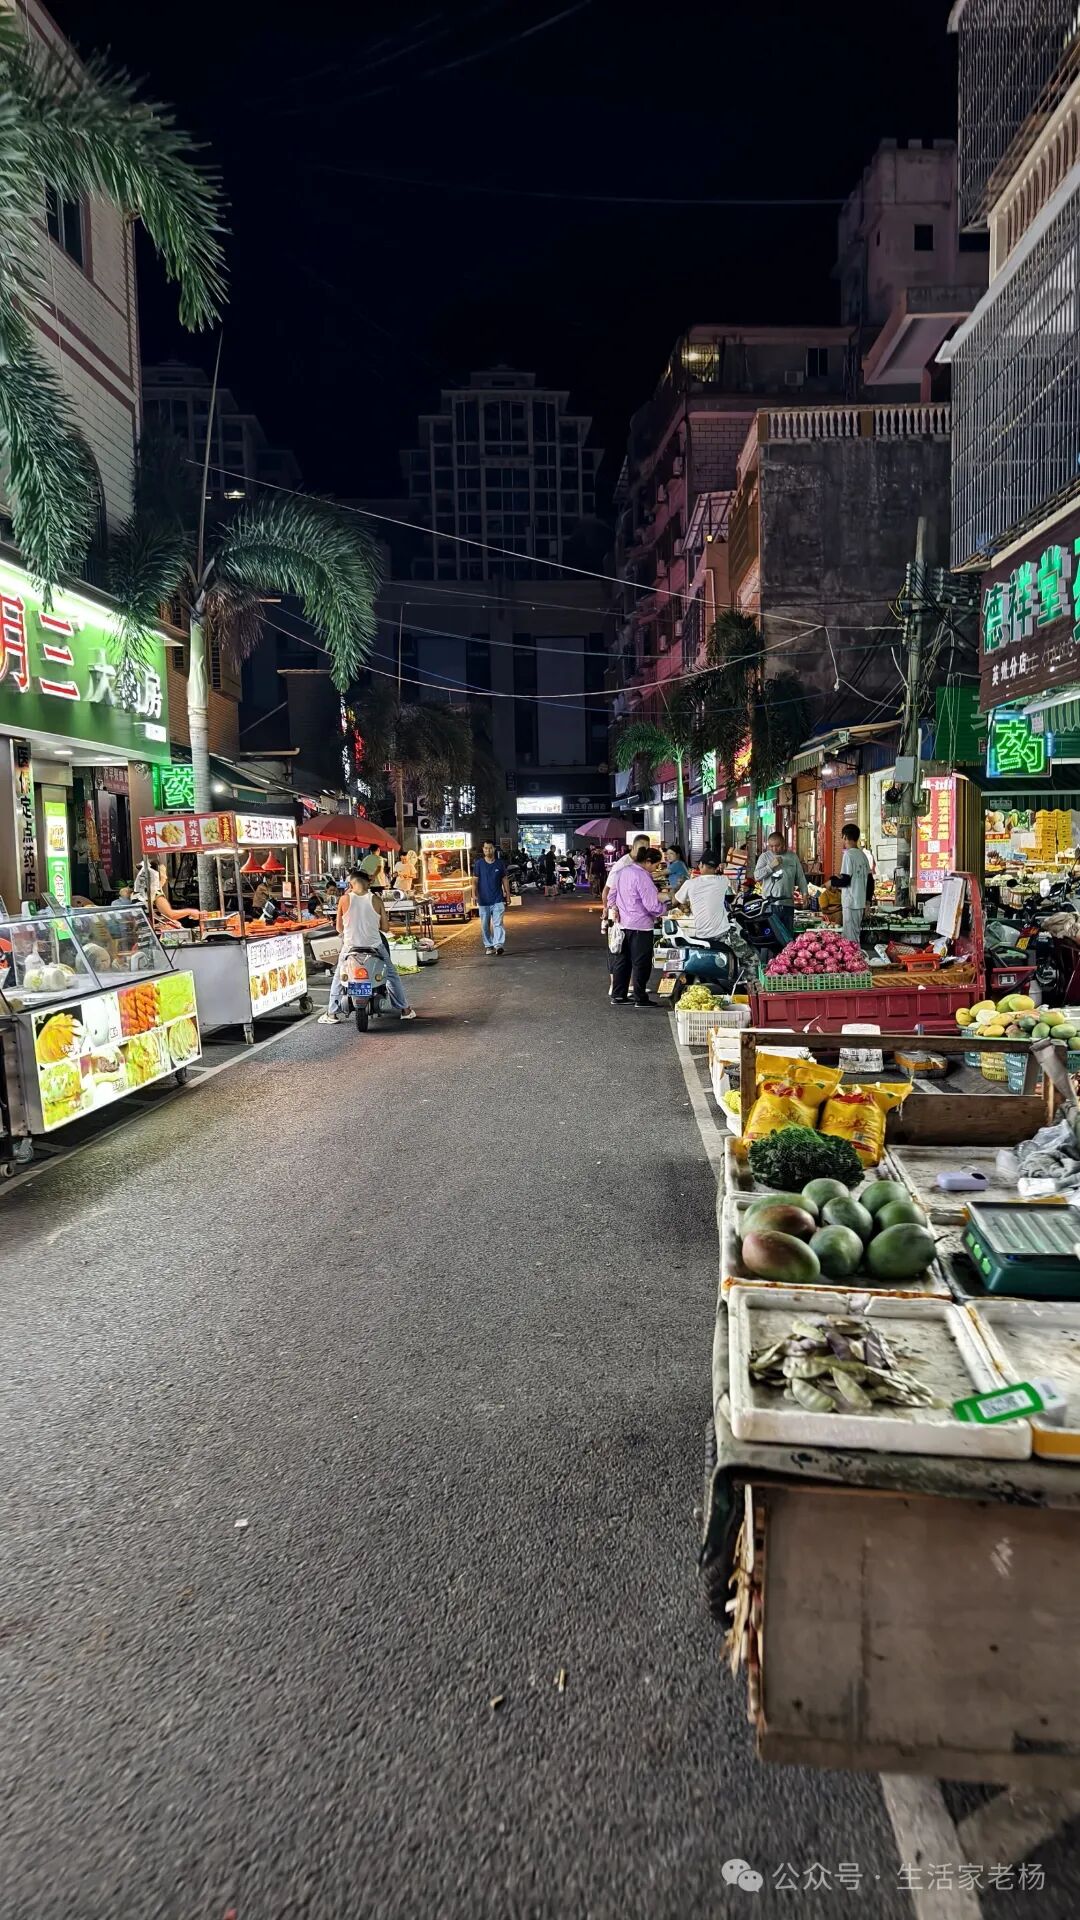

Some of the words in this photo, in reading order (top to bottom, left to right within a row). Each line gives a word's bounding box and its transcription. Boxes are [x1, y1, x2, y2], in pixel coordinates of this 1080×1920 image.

[982, 537, 1080, 655] 德祥堂
[996, 719, 1044, 773] 药
[161, 767, 195, 807] 药
[144, 824, 157, 847] 炸鸡
[188, 819, 200, 845] 炸丸子
